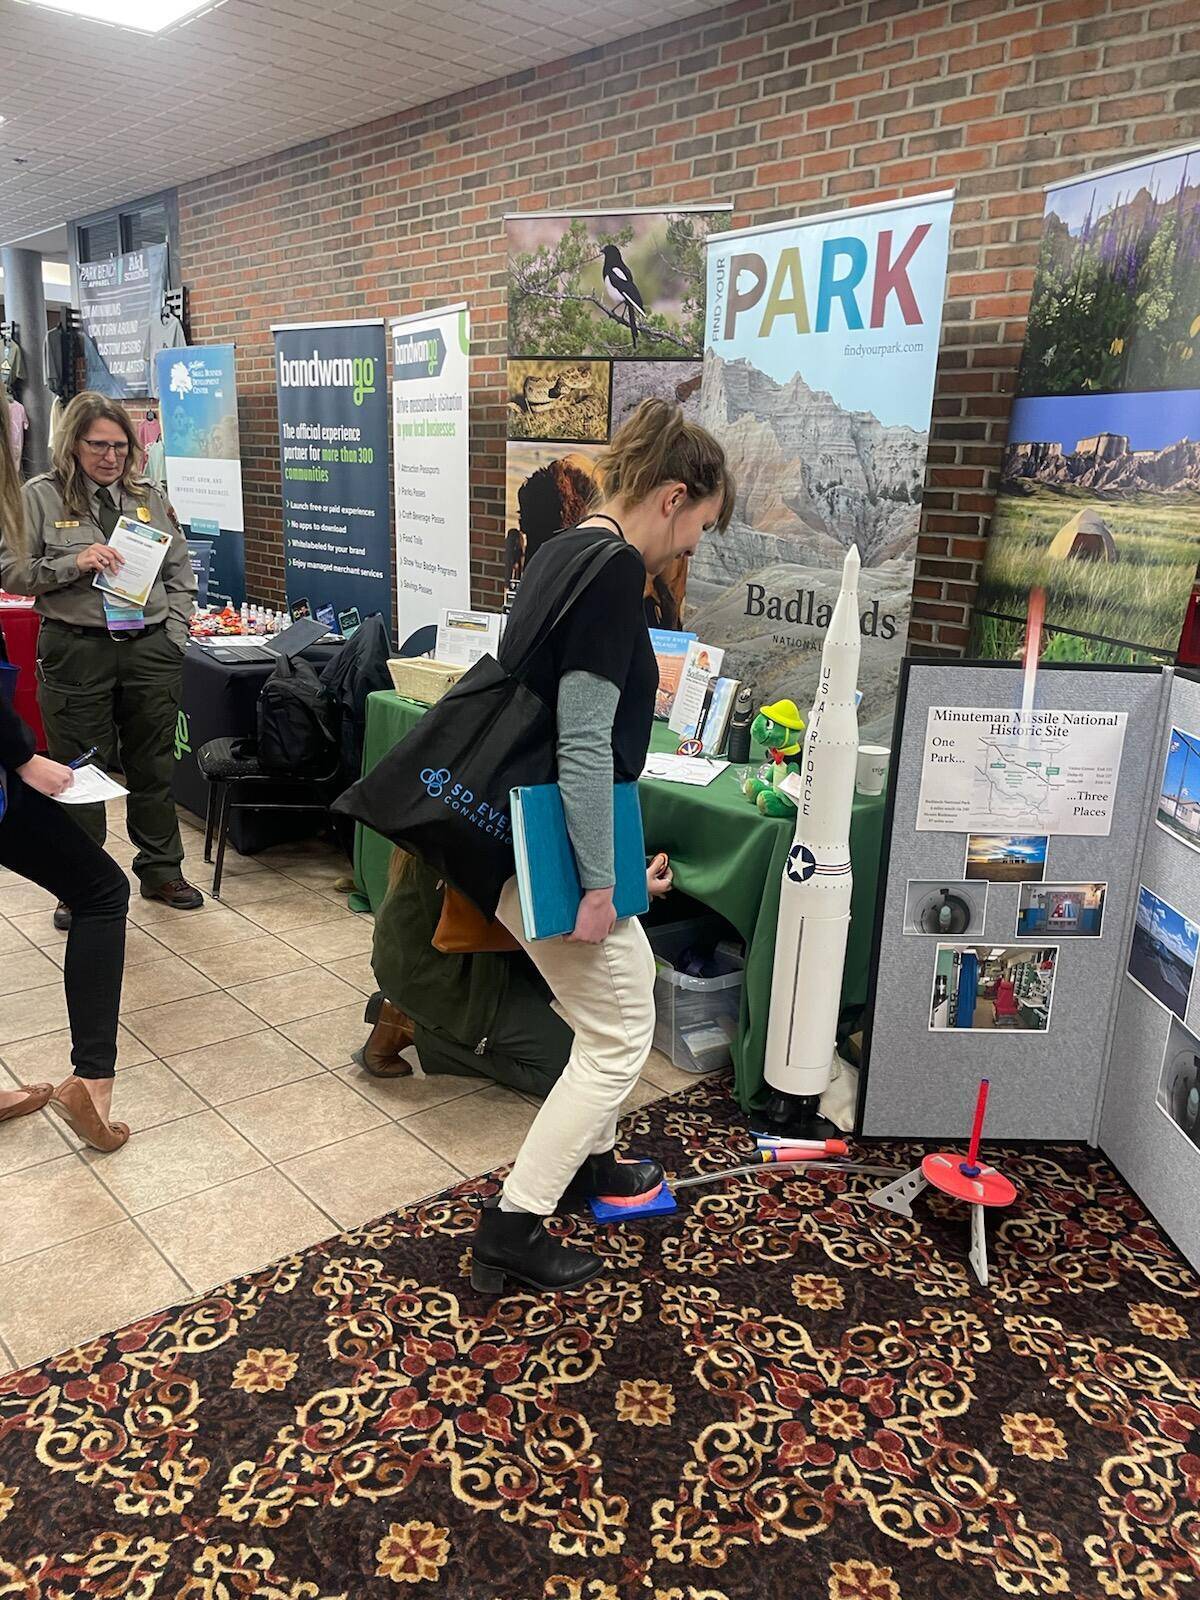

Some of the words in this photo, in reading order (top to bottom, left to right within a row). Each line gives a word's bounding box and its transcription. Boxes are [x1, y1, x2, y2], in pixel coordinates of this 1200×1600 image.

[715, 257, 727, 304] YOUR
[723, 222, 933, 340] PARK
[712, 306, 722, 342] FIND
[843, 341, 924, 357] findyourpark.com
[282, 423, 295, 439] The
[295, 422, 321, 440] official
[321, 425, 361, 444] experience
[283, 446, 308, 463] partner
[309, 444, 321, 461] for
[322, 448, 339, 462] more
[340, 446, 358, 463] than
[358, 447, 374, 464] 300
[285, 466, 329, 482] communities
[290, 501, 309, 510] Launch
[309, 503, 322, 511] free
[328, 505, 340, 514] paid
[341, 507, 376, 517] experiences
[291, 520, 299, 528] No
[299, 523, 312, 531] apps
[313, 523, 321, 531] to
[321, 524, 347, 533] download
[327, 543, 335, 552] for
[335, 545, 349, 554] your
[349, 546, 366, 556] brand
[292, 559, 306, 569] Enjoy
[307, 562, 333, 572] managed
[333, 565, 360, 575] merchant
[361, 569, 384, 579] services
[744, 583, 896, 640] Badlads
[772, 634, 824, 651] NATIONAL
[933, 709, 1010, 723] Minuteman
[1062, 714, 1118, 726] National
[990, 724, 1042, 737] Historic
[1045, 724, 1069, 737] Site
[932, 737, 955, 747] One
[931, 752, 965, 763] Park...
[802, 745, 816, 816] FORCE
[450, 783, 474, 804] SD
[1067, 791, 1109, 802] ...Three
[477, 802, 512, 832] EVE
[1073, 806, 1106, 817] Places
